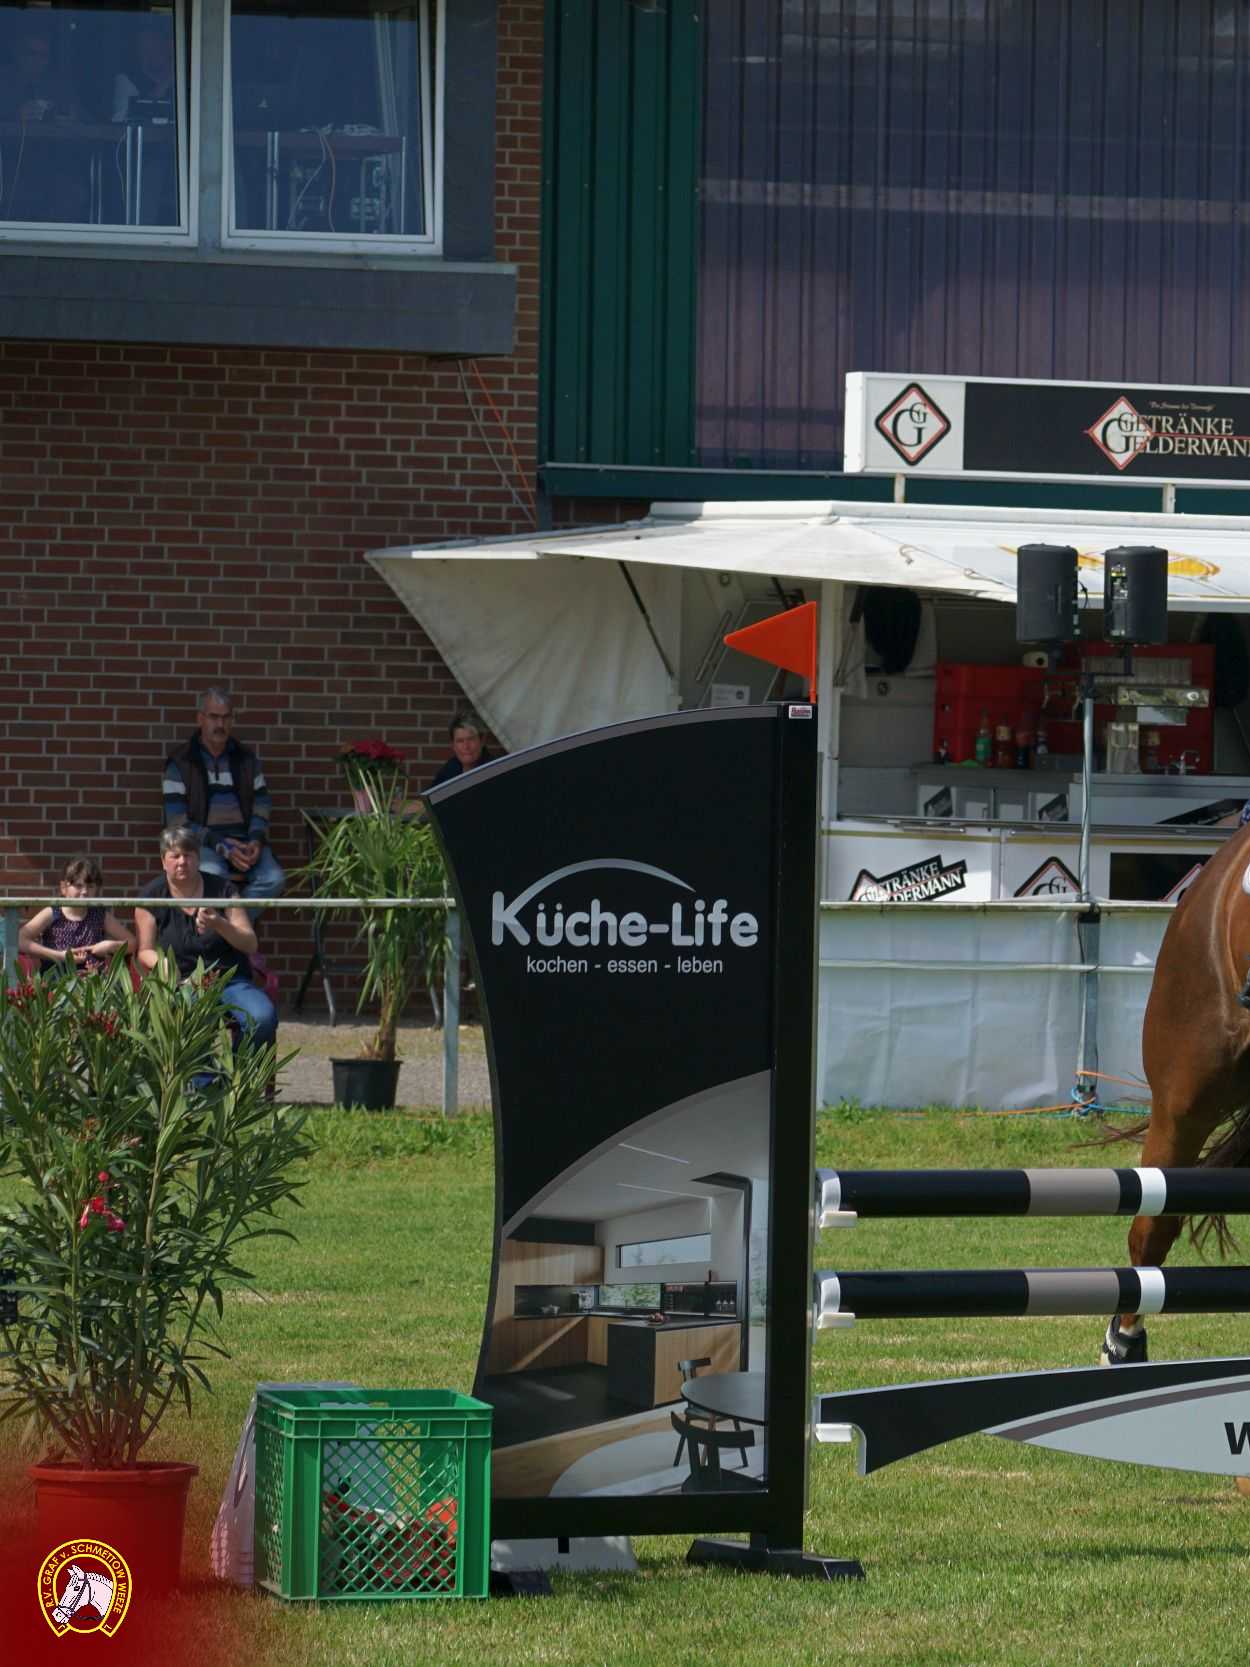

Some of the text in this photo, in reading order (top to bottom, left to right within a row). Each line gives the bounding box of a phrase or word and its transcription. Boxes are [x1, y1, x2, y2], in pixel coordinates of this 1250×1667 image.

[1117, 412, 1235, 437] GETRÄNKE
[862, 868, 964, 901] DERMANN
[490, 890, 759, 947] Küche-Life
[527, 955, 588, 973] kochen
[607, 959, 658, 973] essen
[677, 956, 723, 974] leben
